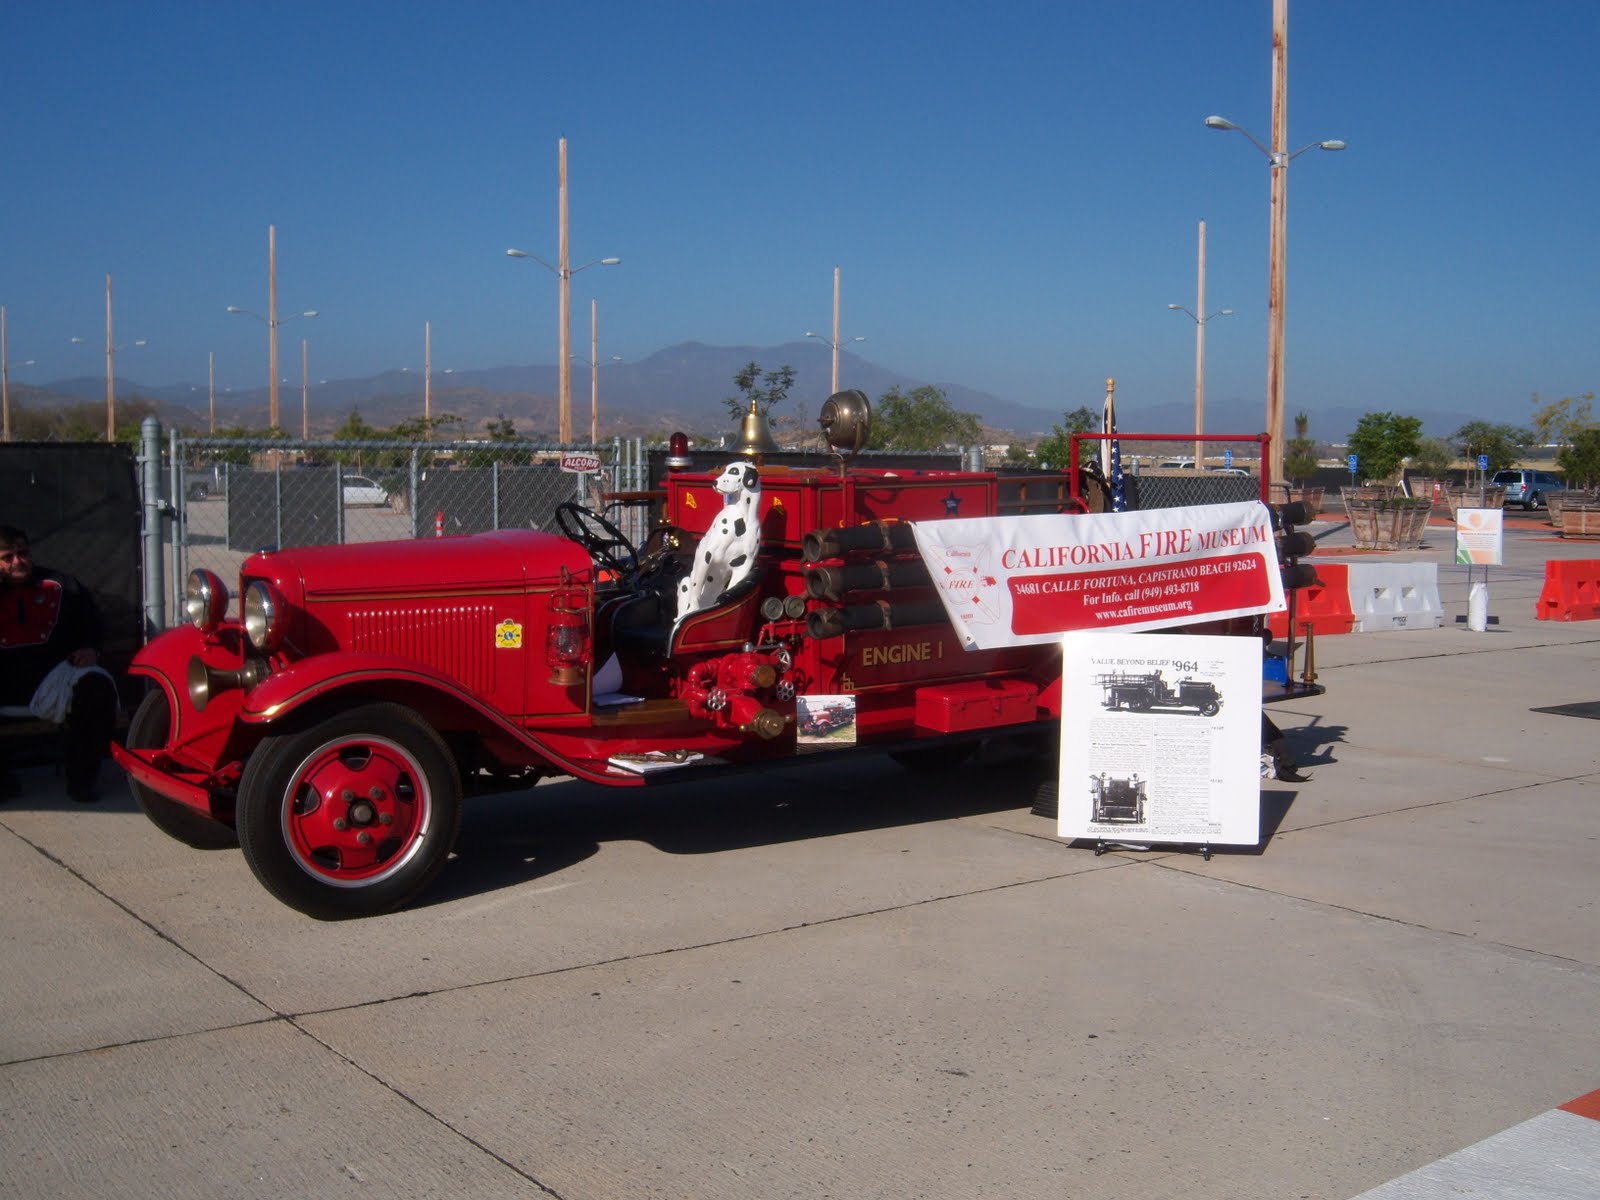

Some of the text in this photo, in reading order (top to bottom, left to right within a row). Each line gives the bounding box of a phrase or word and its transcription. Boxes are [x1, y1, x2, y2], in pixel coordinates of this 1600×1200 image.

[565, 458, 599, 468] ALCORN
[1002, 525, 1267, 569] CALIFORNIA FIRE MUSEUM
[948, 580, 974, 589] FIRE
[1014, 559, 1257, 595] 34681 CALLE FORTUNA, CAPISTRANO BEACH 92624
[1083, 581, 1200, 606] For Info. call (949) 493-8718
[1096, 600, 1193, 619] www.cafiremuseum.org
[862, 642, 931, 666] ENGINE
[1171, 660, 1199, 672] $964
